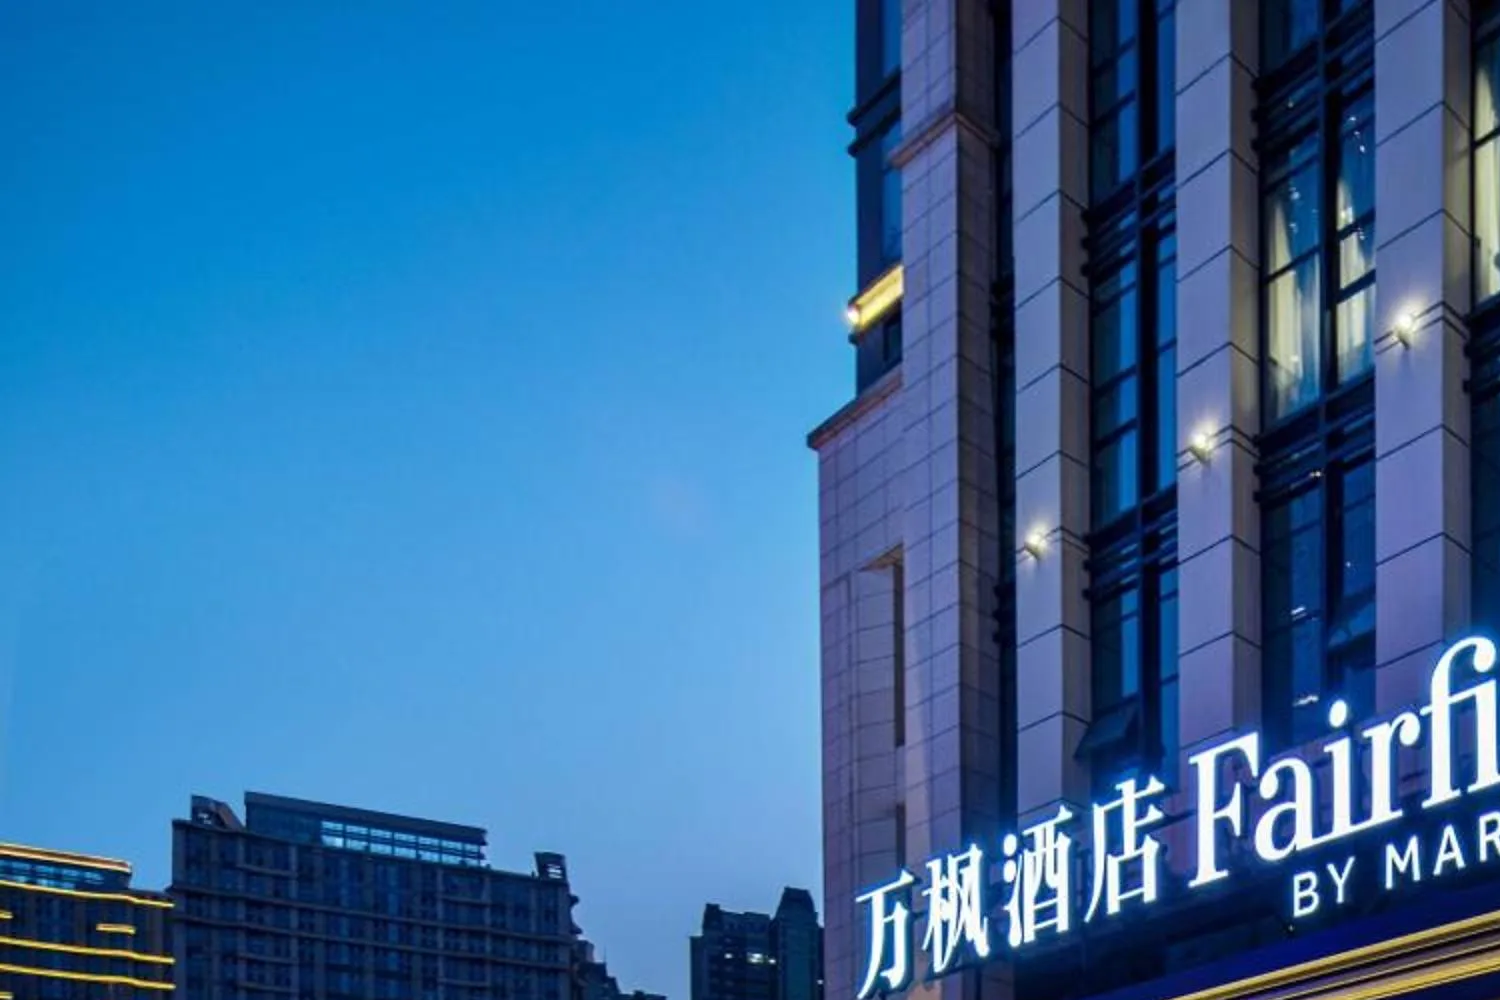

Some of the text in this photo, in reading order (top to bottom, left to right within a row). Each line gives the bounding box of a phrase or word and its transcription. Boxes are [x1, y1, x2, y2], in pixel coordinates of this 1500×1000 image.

[855, 775, 1165, 1000] 万枫酒店
[1292, 855, 1357, 918] BY
